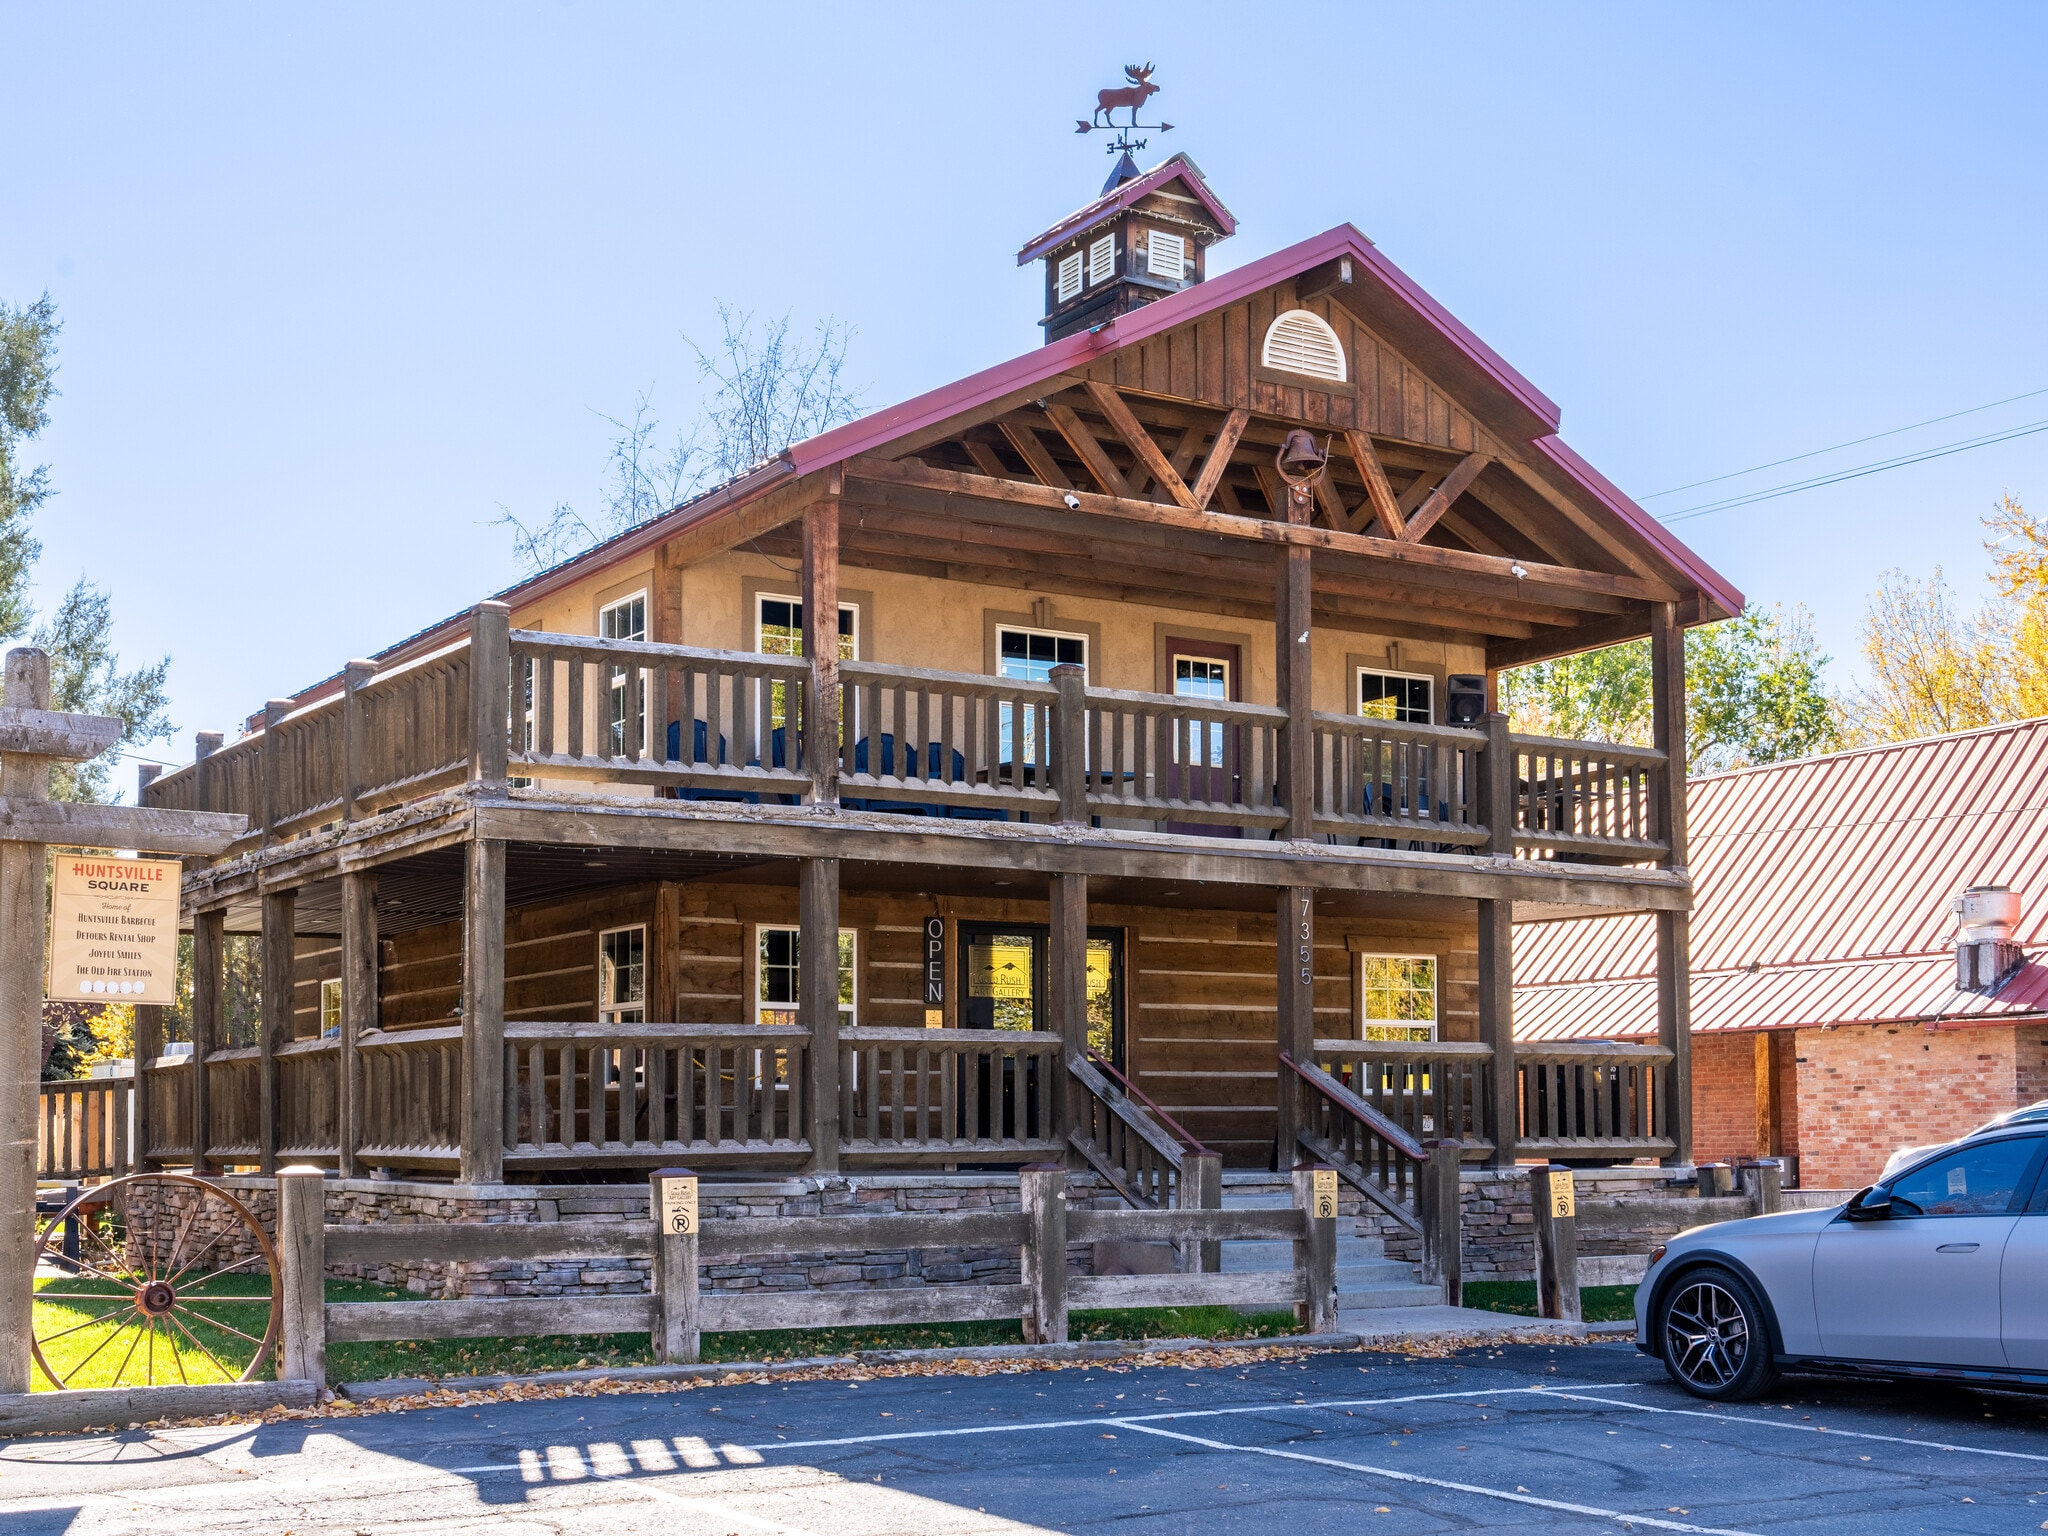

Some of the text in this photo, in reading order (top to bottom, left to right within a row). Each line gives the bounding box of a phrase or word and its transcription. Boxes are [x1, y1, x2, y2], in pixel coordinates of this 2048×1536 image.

[72, 863, 162, 881] HUNTSVILLE
[88, 880, 150, 893] SQUARE
[101, 902, 132, 914] Home of
[78, 913, 156, 927] HUNTSVILLE BARBECUE
[76, 930, 156, 944] DETOURS RENTAL SHOP
[1300, 899, 1311, 985] 7355
[88, 949, 142, 961] JOYFUL SMILES
[928, 919, 943, 1001] OPEN
[76, 965, 153, 978] THE OLD FIRE STATION
[1000, 974, 1021, 985] RUSH
[973, 985, 1025, 997] ART GALLERY
